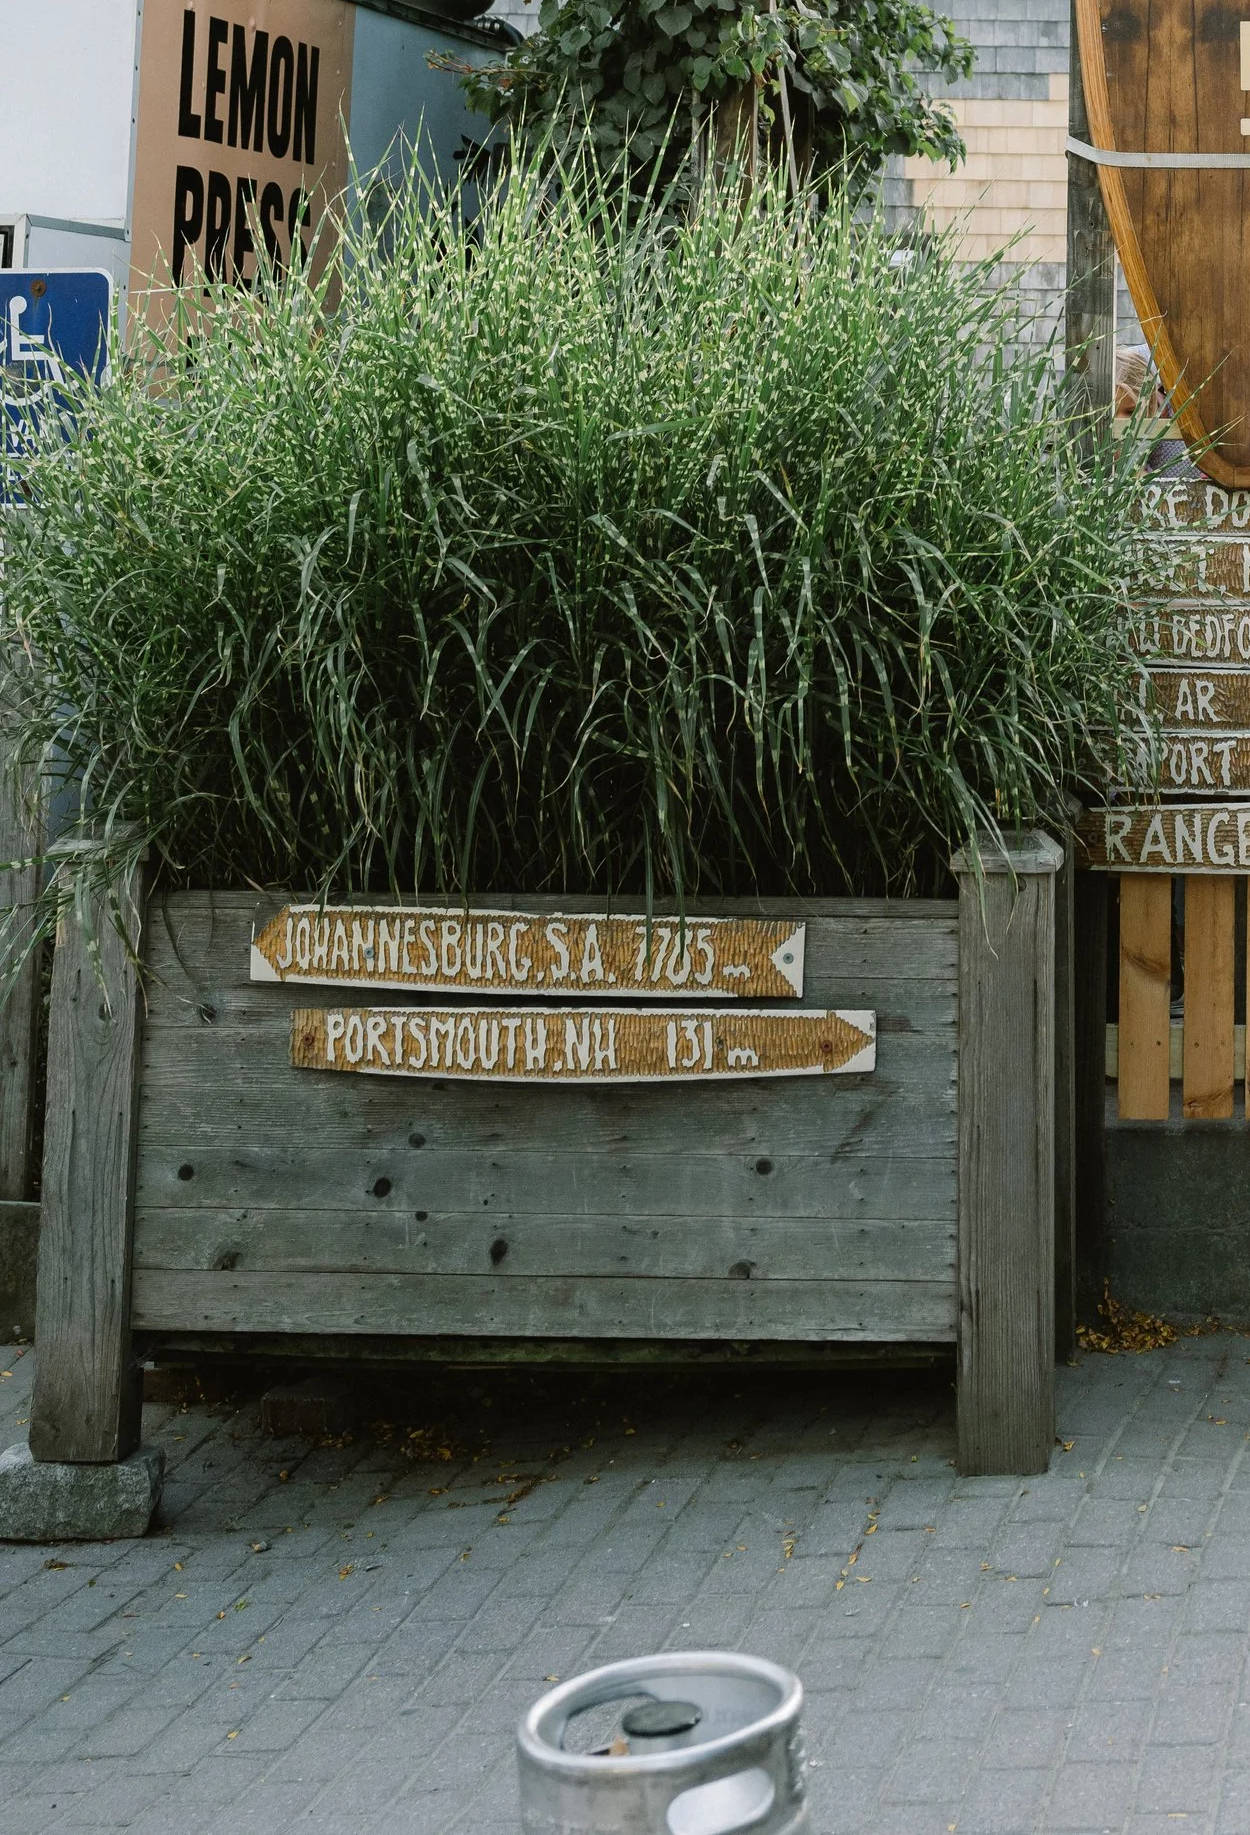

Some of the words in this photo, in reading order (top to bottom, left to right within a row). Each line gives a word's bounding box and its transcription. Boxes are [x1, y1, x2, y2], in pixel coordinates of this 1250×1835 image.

[178, 9, 320, 165] LEMON
[172, 165, 311, 303] PRESS
[1205, 484, 1250, 529] DO
[1175, 678, 1222, 722] AR
[565, 1017, 618, 1069] NH
[666, 1018, 713, 1069] 131
